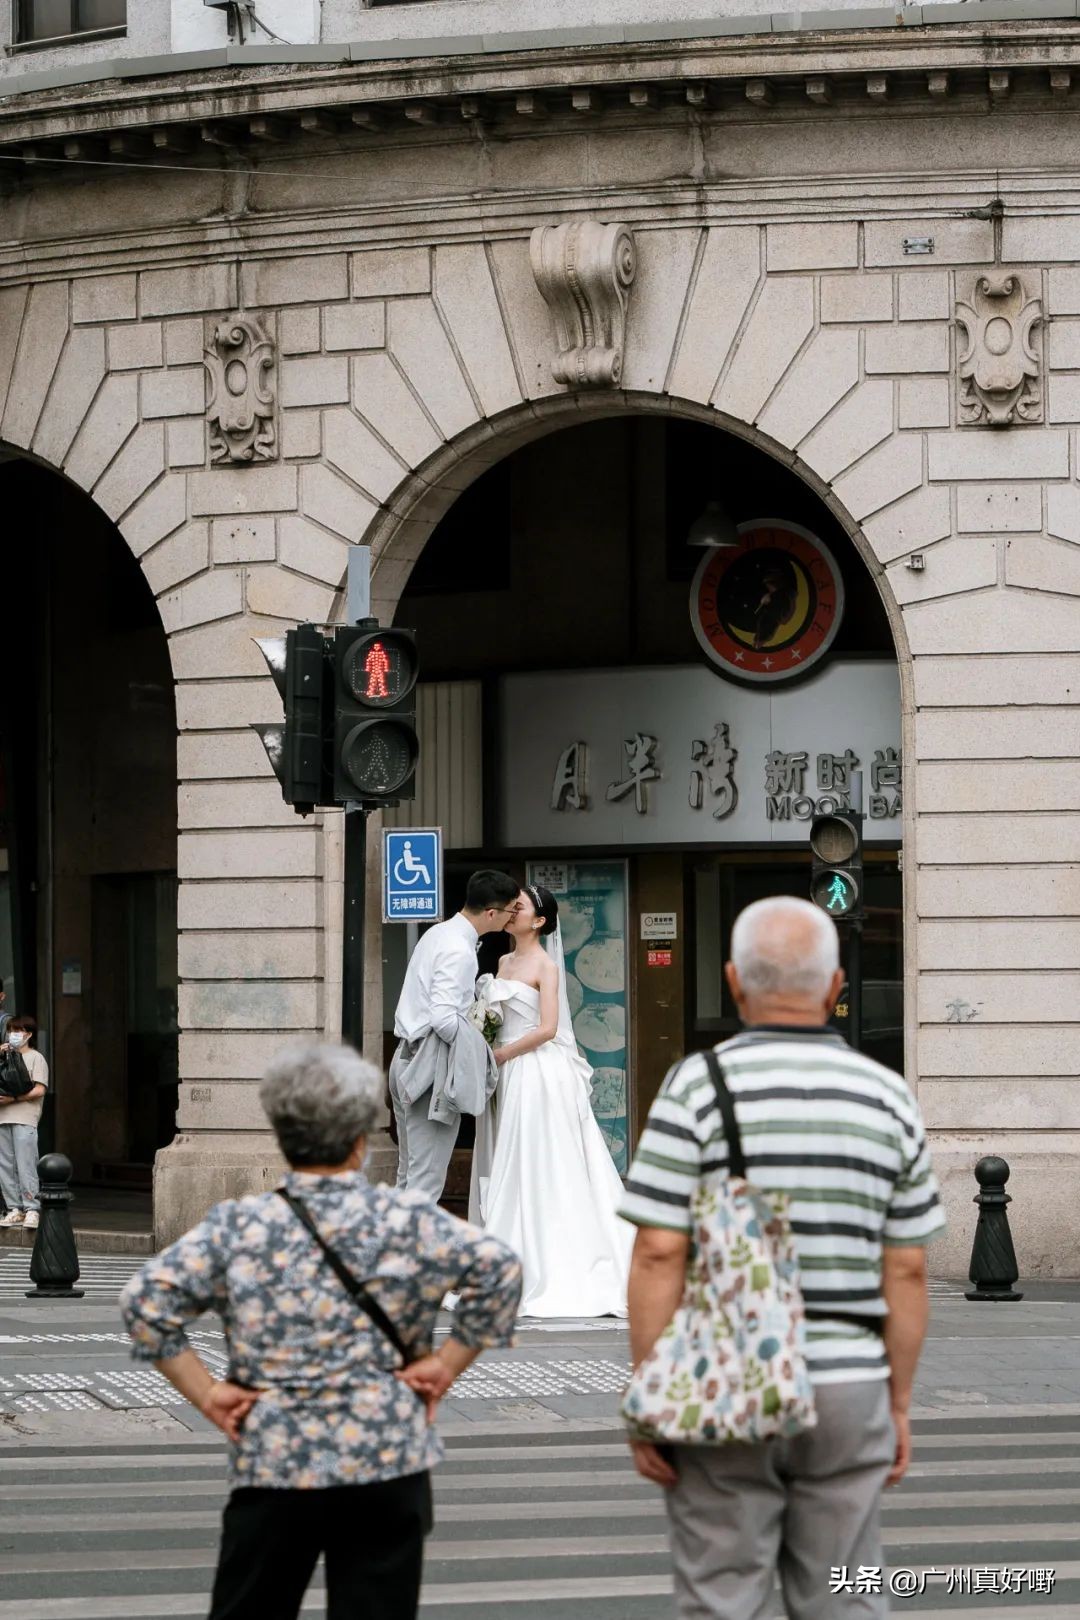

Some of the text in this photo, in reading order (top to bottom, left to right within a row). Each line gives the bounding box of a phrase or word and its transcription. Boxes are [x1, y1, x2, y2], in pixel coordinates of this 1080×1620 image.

[764, 748, 902, 795] 新时尚
[392, 897, 433, 910] 无障碍通道
